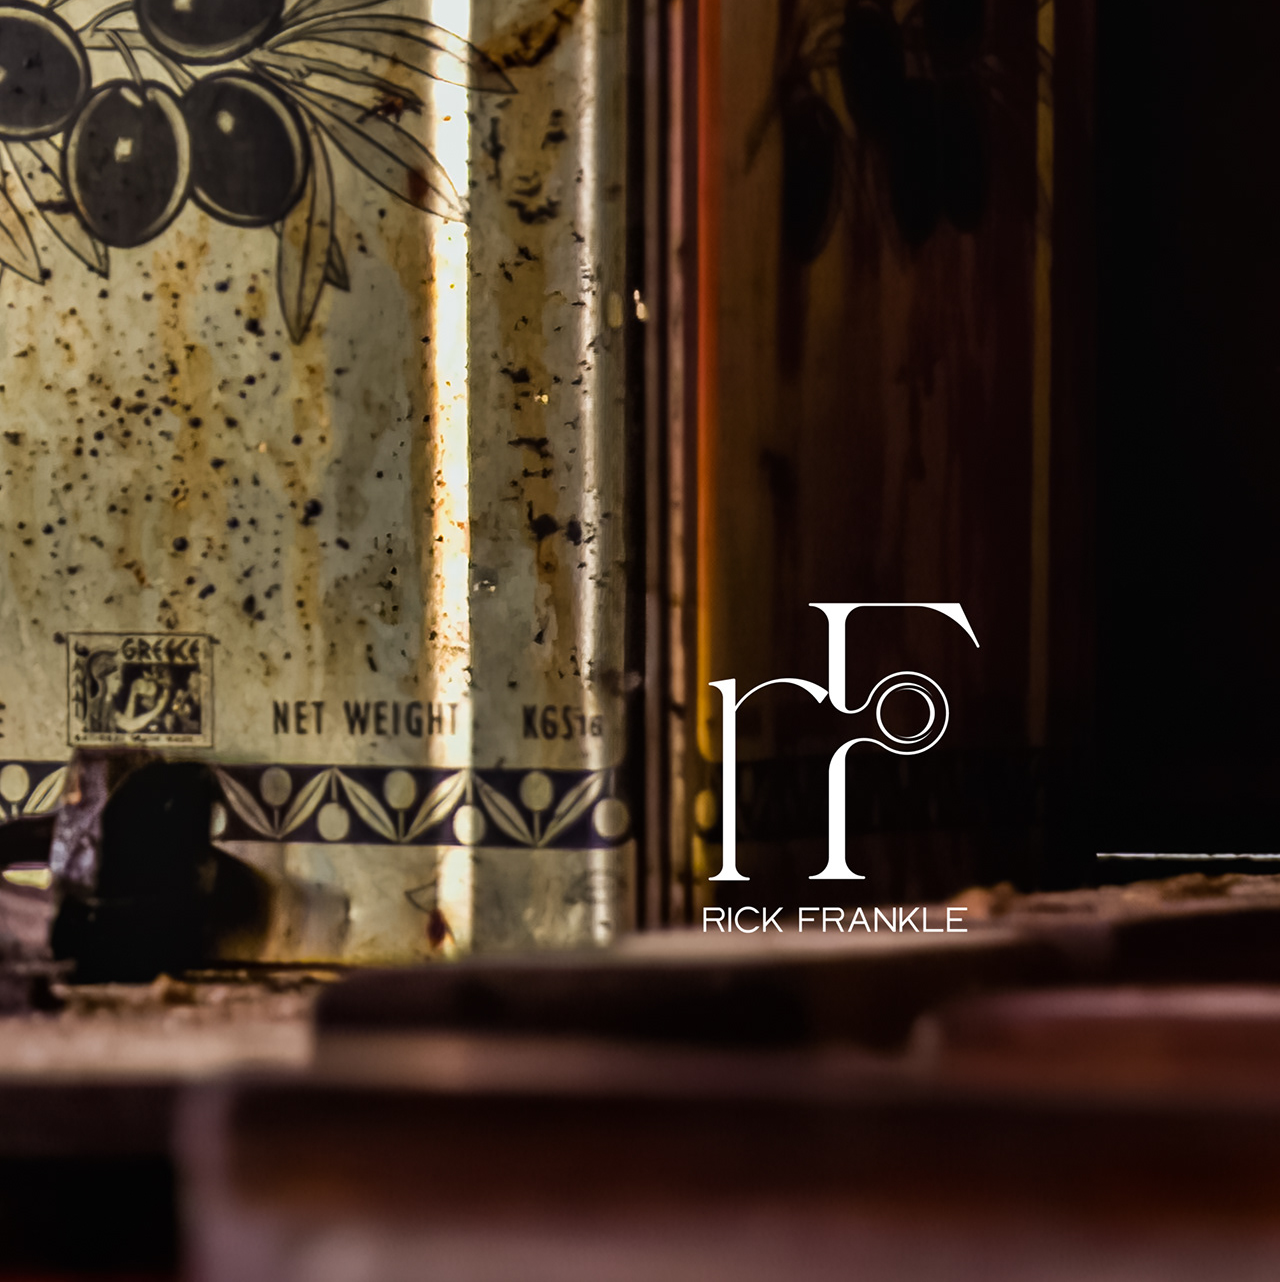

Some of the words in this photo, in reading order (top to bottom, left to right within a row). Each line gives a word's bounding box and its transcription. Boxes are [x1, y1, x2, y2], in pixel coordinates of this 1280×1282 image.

[120, 637, 200, 662] GREECE
[272, 698, 324, 737] NET
[344, 700, 460, 738] WEIGHT
